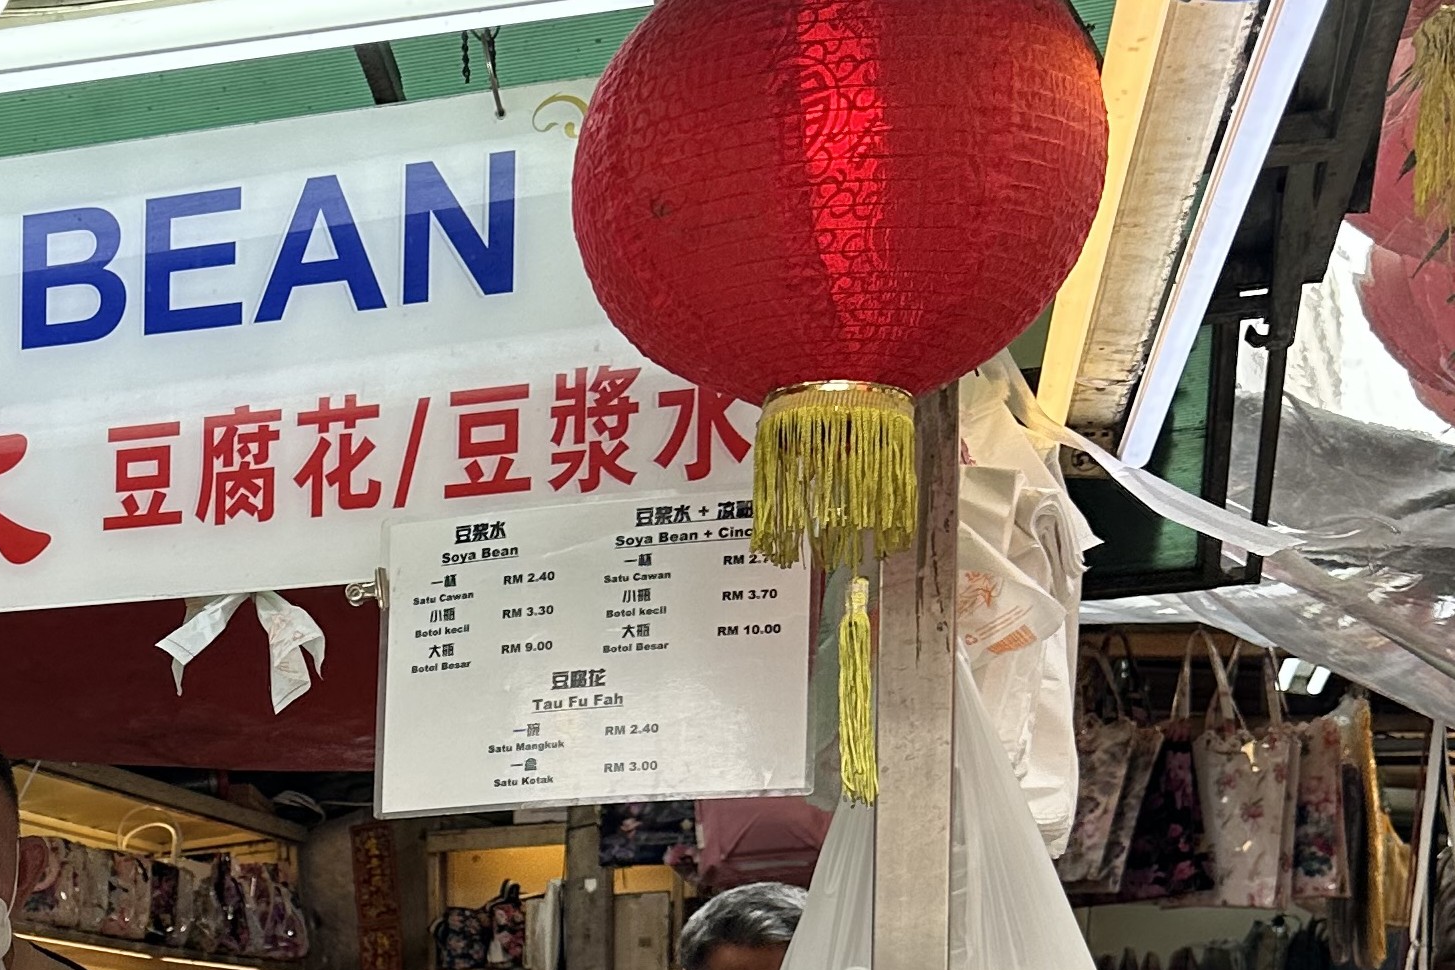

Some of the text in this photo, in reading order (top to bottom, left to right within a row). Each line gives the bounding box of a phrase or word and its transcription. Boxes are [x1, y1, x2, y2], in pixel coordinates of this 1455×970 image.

[21, 150, 516, 350] BEAN
[615, 535, 653, 547] Soya
[659, 531, 698, 542] Bean
[442, 547, 518, 564] Soya Bean
[723, 555, 744, 565] RM
[504, 571, 555, 585] RM 2.40
[604, 572, 671, 583] Satu Cawan
[413, 592, 474, 605] Satu Cawan
[722, 589, 777, 600] RM 3.70
[502, 605, 553, 619] RM 3.30
[606, 606, 666, 618] Botol kecil
[415, 624, 470, 638] Botol kecil
[717, 624, 781, 636] RM 10.00
[501, 641, 553, 654] RM 9.00
[603, 642, 669, 653] Botol Besar
[411, 661, 471, 673] Botol Besar
[532, 693, 623, 710] Tau Fu Fah
[605, 724, 659, 736] RM 2.40
[488, 740, 564, 753] Satu Mangkuk
[604, 761, 657, 773] RM 3.00
[494, 775, 553, 787] Satu Kotak
